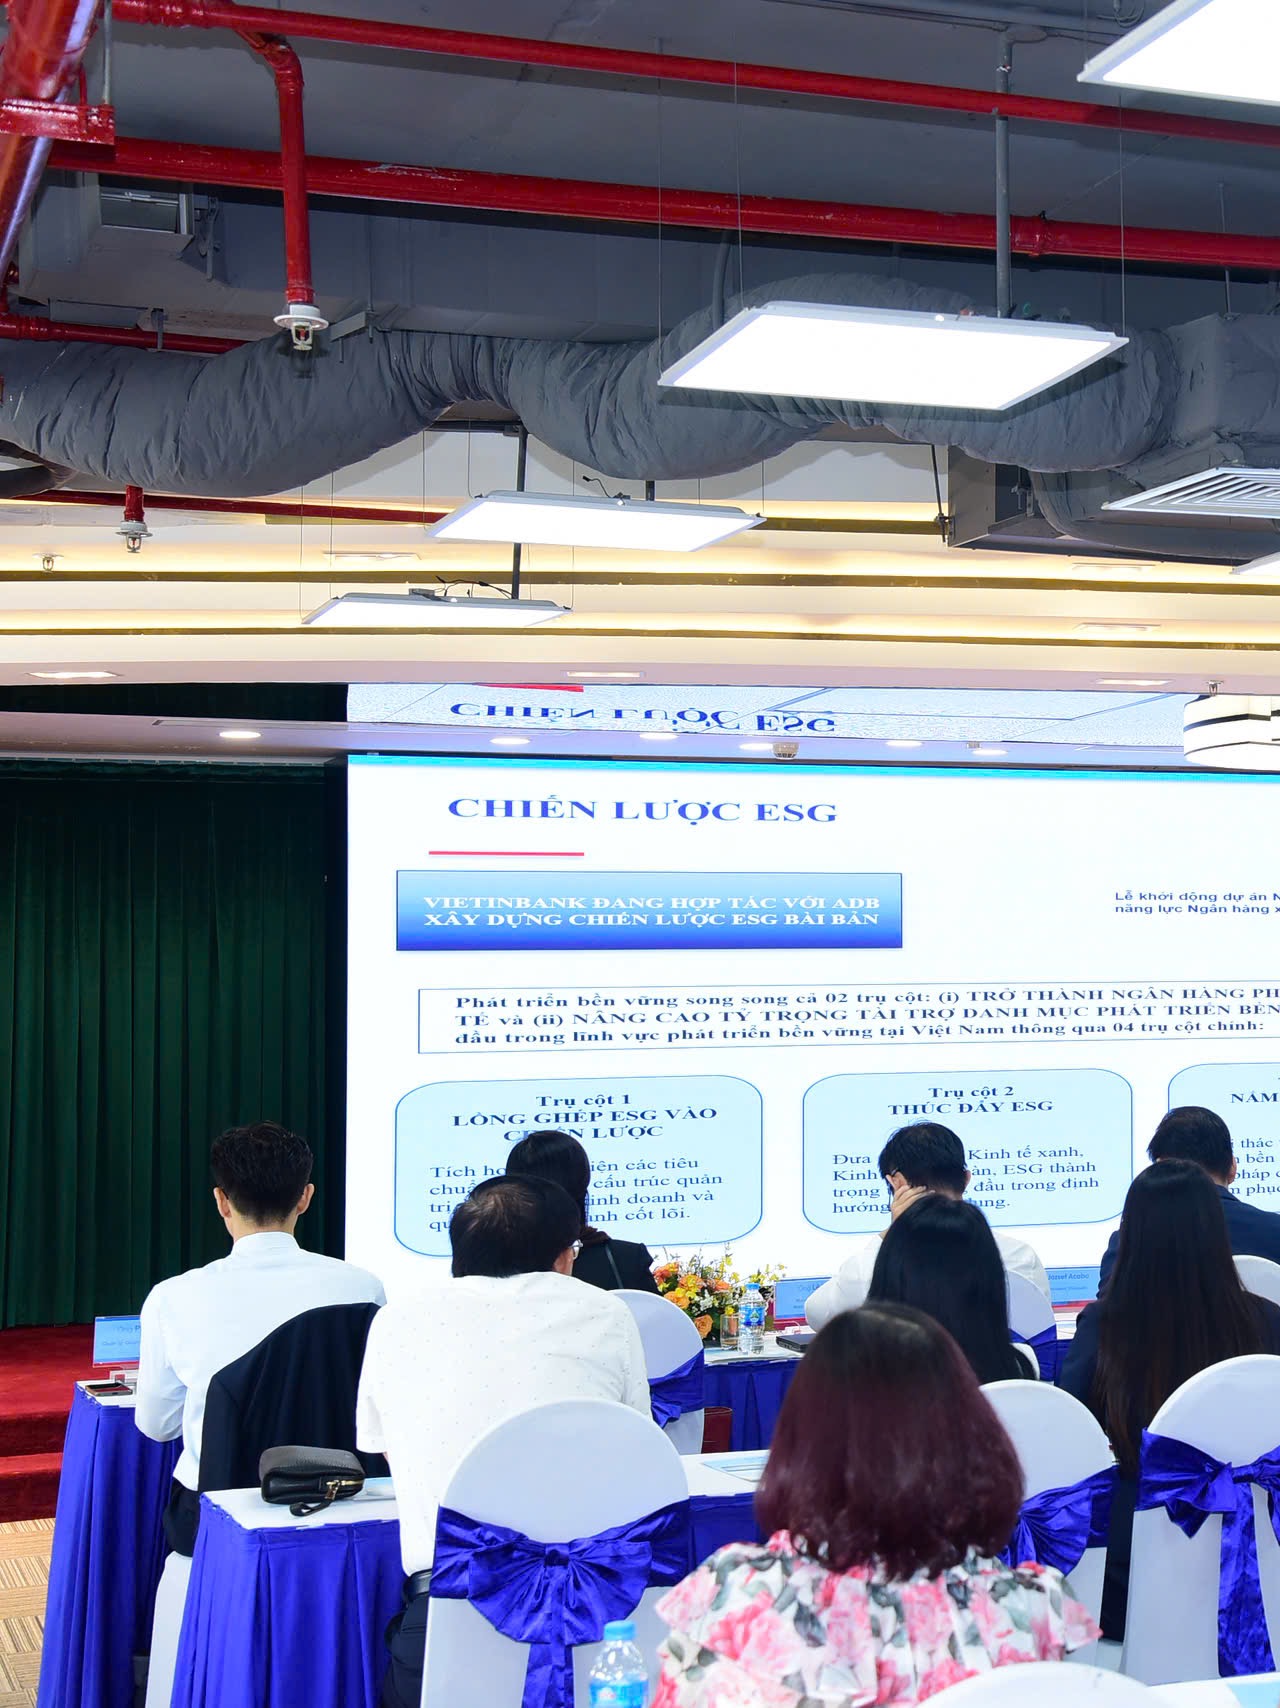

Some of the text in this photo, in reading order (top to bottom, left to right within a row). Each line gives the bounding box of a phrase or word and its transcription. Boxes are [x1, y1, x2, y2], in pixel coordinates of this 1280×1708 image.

[447, 794, 837, 826] CHIẾN LƯỢC ESG
[423, 896, 588, 909] VIETINBANK
[591, 895, 665, 909] ĐANG
[727, 895, 777, 910] TÁC
[831, 897, 881, 909] ADB
[1115, 889, 1134, 901] Lễ
[1178, 891, 1218, 903] động
[1115, 903, 1153, 915] năng
[1158, 904, 1183, 915] lực
[1187, 903, 1228, 915] Ngân
[423, 910, 481, 926] XÂY
[486, 911, 563, 929] DỰNG
[655, 912, 726, 929] LƯỢC
[731, 913, 778, 926] ESG
[783, 911, 825, 926] BÀI
[516, 992, 568, 1008] triển
[577, 992, 616, 1007] bền
[623, 995, 679, 1009] vững
[685, 997, 734, 1008] song
[741, 996, 789, 1007] song
[825, 992, 849, 1004] 02
[856, 993, 887, 1006] trụ
[894, 991, 930, 1005] cột:
[938, 991, 960, 1005] (i)
[533, 1014, 564, 1028] (ii)
[655, 1011, 711, 1023] CAO
[759, 1009, 848, 1024] TRỌNG
[904, 1007, 956, 1022] TRỢ
[963, 1007, 1029, 1019] DANH
[1036, 1006, 1089, 1020] MỤC
[455, 1029, 497, 1044] đầu
[505, 1033, 566, 1046] trong
[573, 1030, 613, 1042] lĩnh
[621, 1032, 660, 1044] vực
[778, 1024, 815, 1038] bền
[821, 1027, 873, 1040] vững
[879, 1025, 905, 1039] tại
[911, 1024, 951, 1038] Việt
[959, 1024, 1005, 1035] Nam
[1011, 1023, 1066, 1036] thông
[1071, 1025, 1106, 1036] qua
[1112, 1022, 1135, 1032] 04
[1140, 1023, 1168, 1035] trụ
[1174, 1020, 1201, 1034] cột
[927, 1085, 1016, 1101] Trụ cột 2
[535, 1094, 632, 1109] Trụ cột 1
[887, 1100, 1053, 1116] THÚC ESG
[609, 1109, 657, 1122] ESG
[591, 1125, 663, 1140] LƯỢC
[1240, 1137, 1273, 1149] thác
[833, 1144, 1084, 1165] Đưa Kinh tế xanh,
[1245, 1150, 1275, 1164] bền
[429, 1165, 477, 1178] Tích
[625, 1158, 657, 1171] các
[663, 1157, 699, 1170] tiêu
[833, 1168, 878, 1182] Kinh
[1002, 1163, 1044, 1175] ESG
[592, 1173, 627, 1189] cấu
[633, 1175, 671, 1188] trúc
[832, 1186, 881, 1199] trọng
[973, 1177, 1005, 1193] đầu
[1011, 1181, 1057, 1192] trong
[626, 1189, 715, 1205] doanh và
[624, 1206, 655, 1221] cốt
[661, 1207, 691, 1220] lõi.
[832, 1199, 890, 1214] hướng
